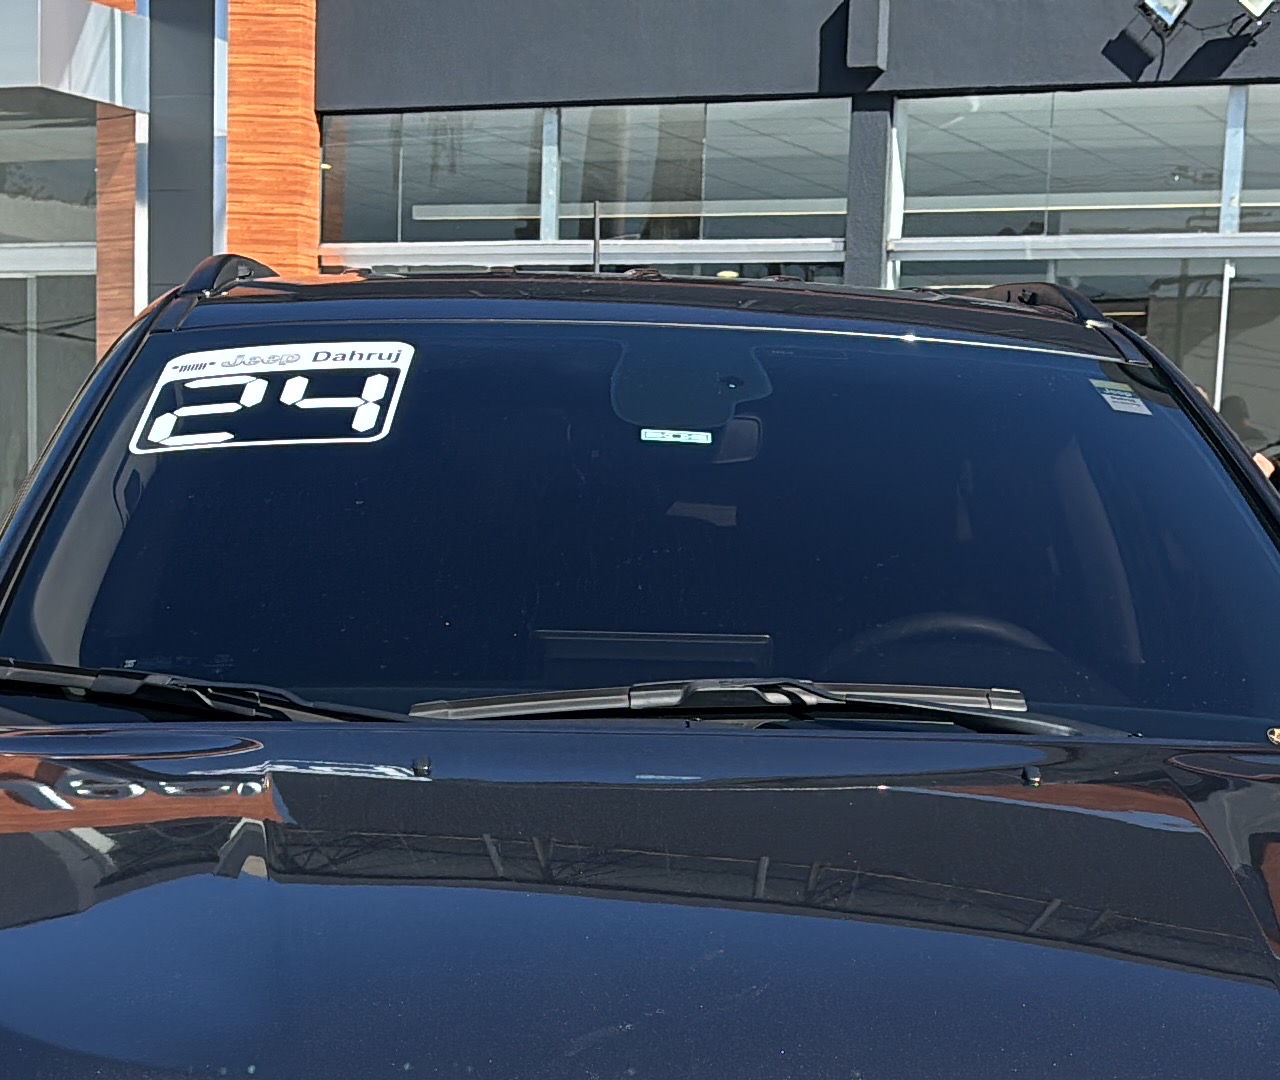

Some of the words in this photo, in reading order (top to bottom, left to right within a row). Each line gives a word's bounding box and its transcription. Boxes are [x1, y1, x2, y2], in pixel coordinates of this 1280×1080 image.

[220, 354, 301, 367] Jeep
[312, 349, 402, 364] Dahruj
[147, 373, 389, 446] 24
